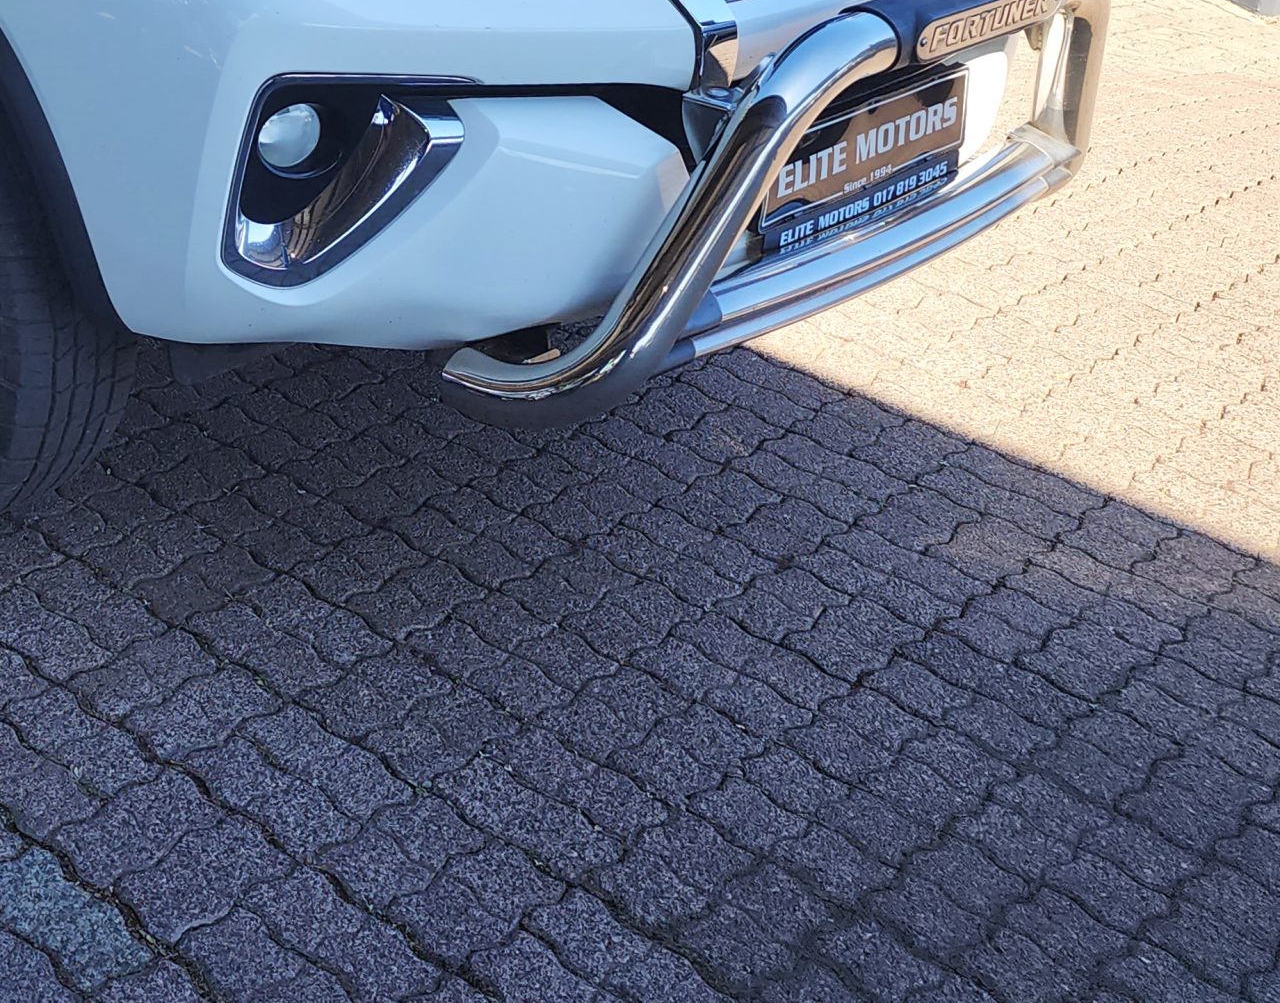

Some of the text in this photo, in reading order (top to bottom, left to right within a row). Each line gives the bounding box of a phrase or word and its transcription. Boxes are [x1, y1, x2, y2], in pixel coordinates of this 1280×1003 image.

[777, 96, 958, 198] ELITE MOTORS
[843, 163, 893, 194] Since 1994
[779, 160, 948, 247] ELITE MOTORS 017 819 3045
